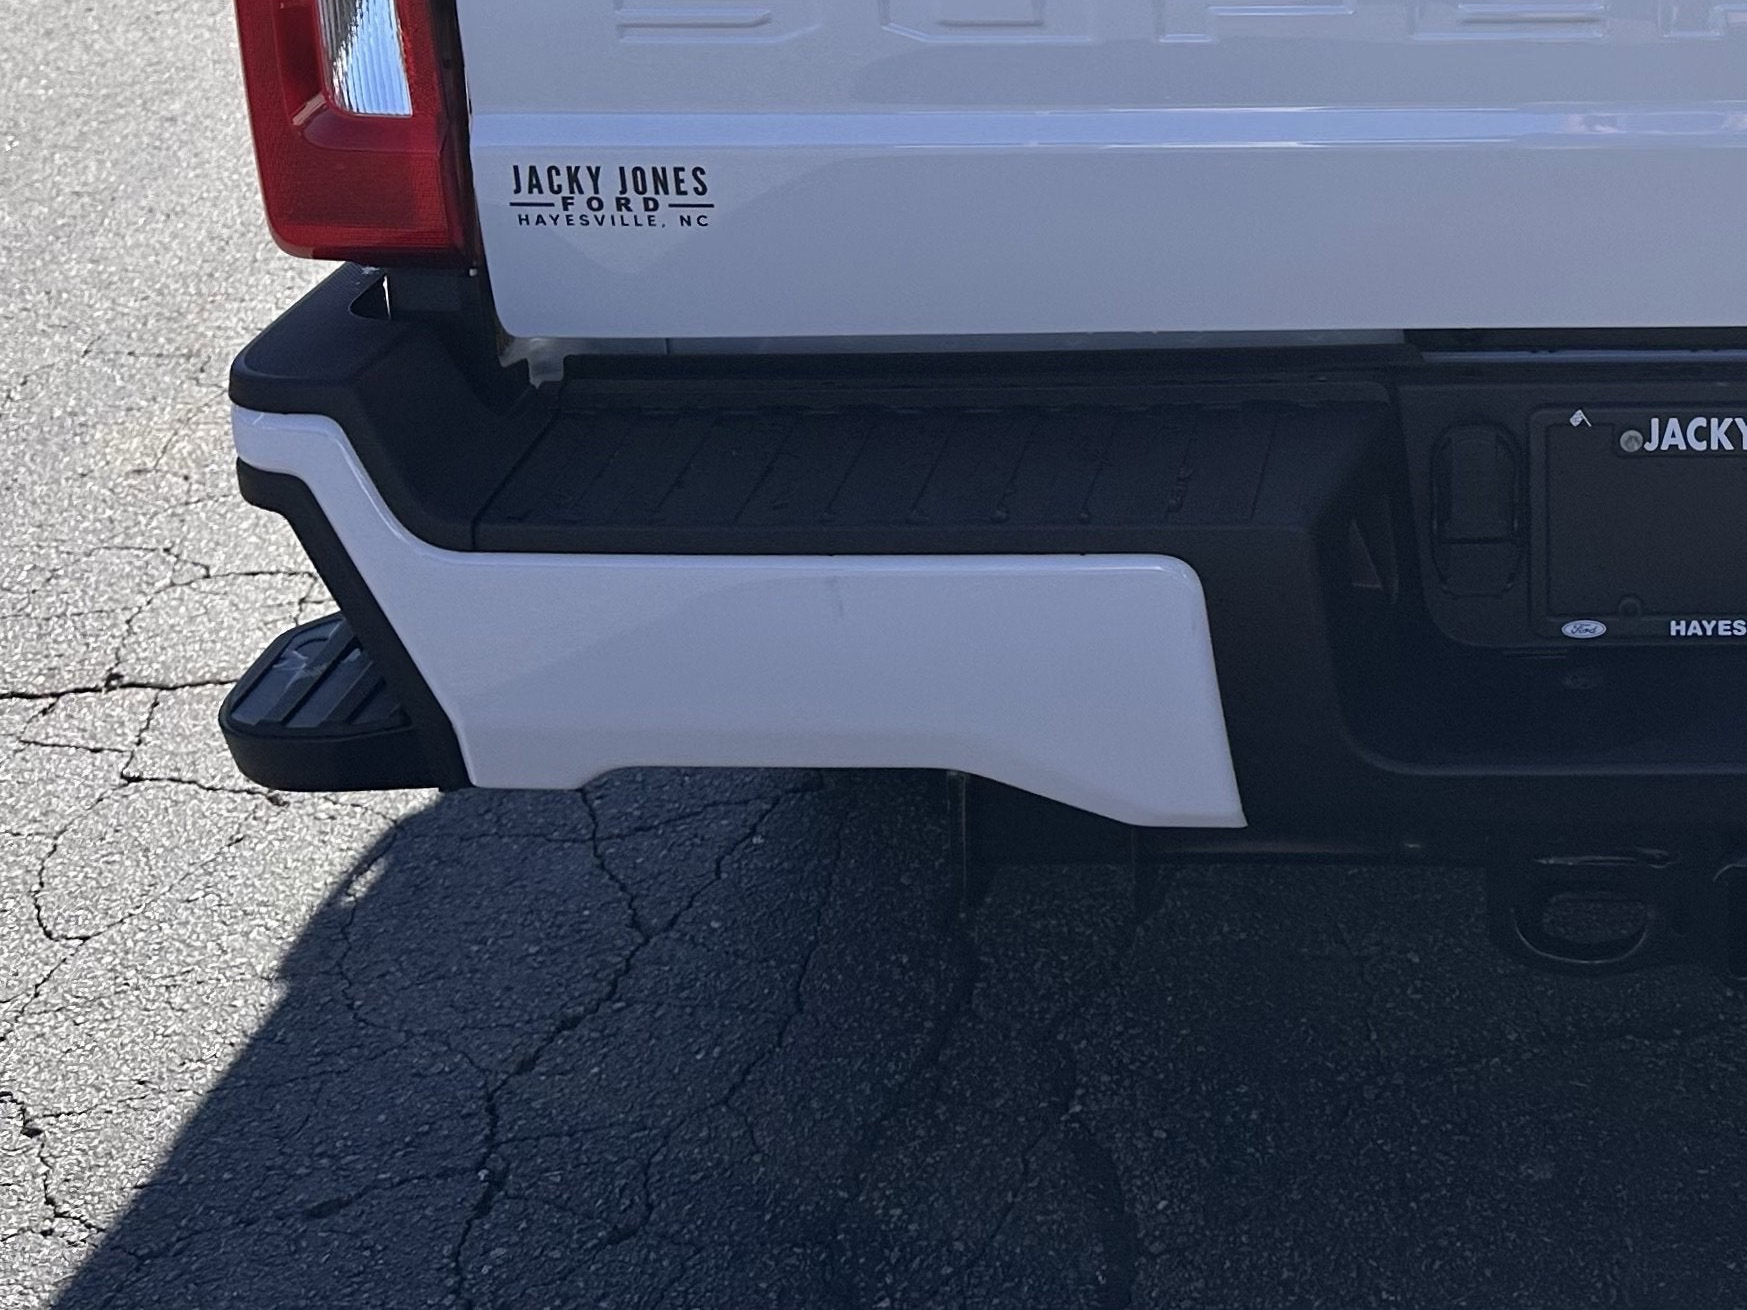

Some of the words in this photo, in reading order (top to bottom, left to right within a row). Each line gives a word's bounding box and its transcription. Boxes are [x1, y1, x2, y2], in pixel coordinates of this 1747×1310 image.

[512, 164, 602, 195] JACKY
[618, 165, 709, 197] JONES
[560, 195, 661, 213] FORD
[517, 213, 667, 229] HAYESVILLE,
[679, 214, 710, 228] NC
